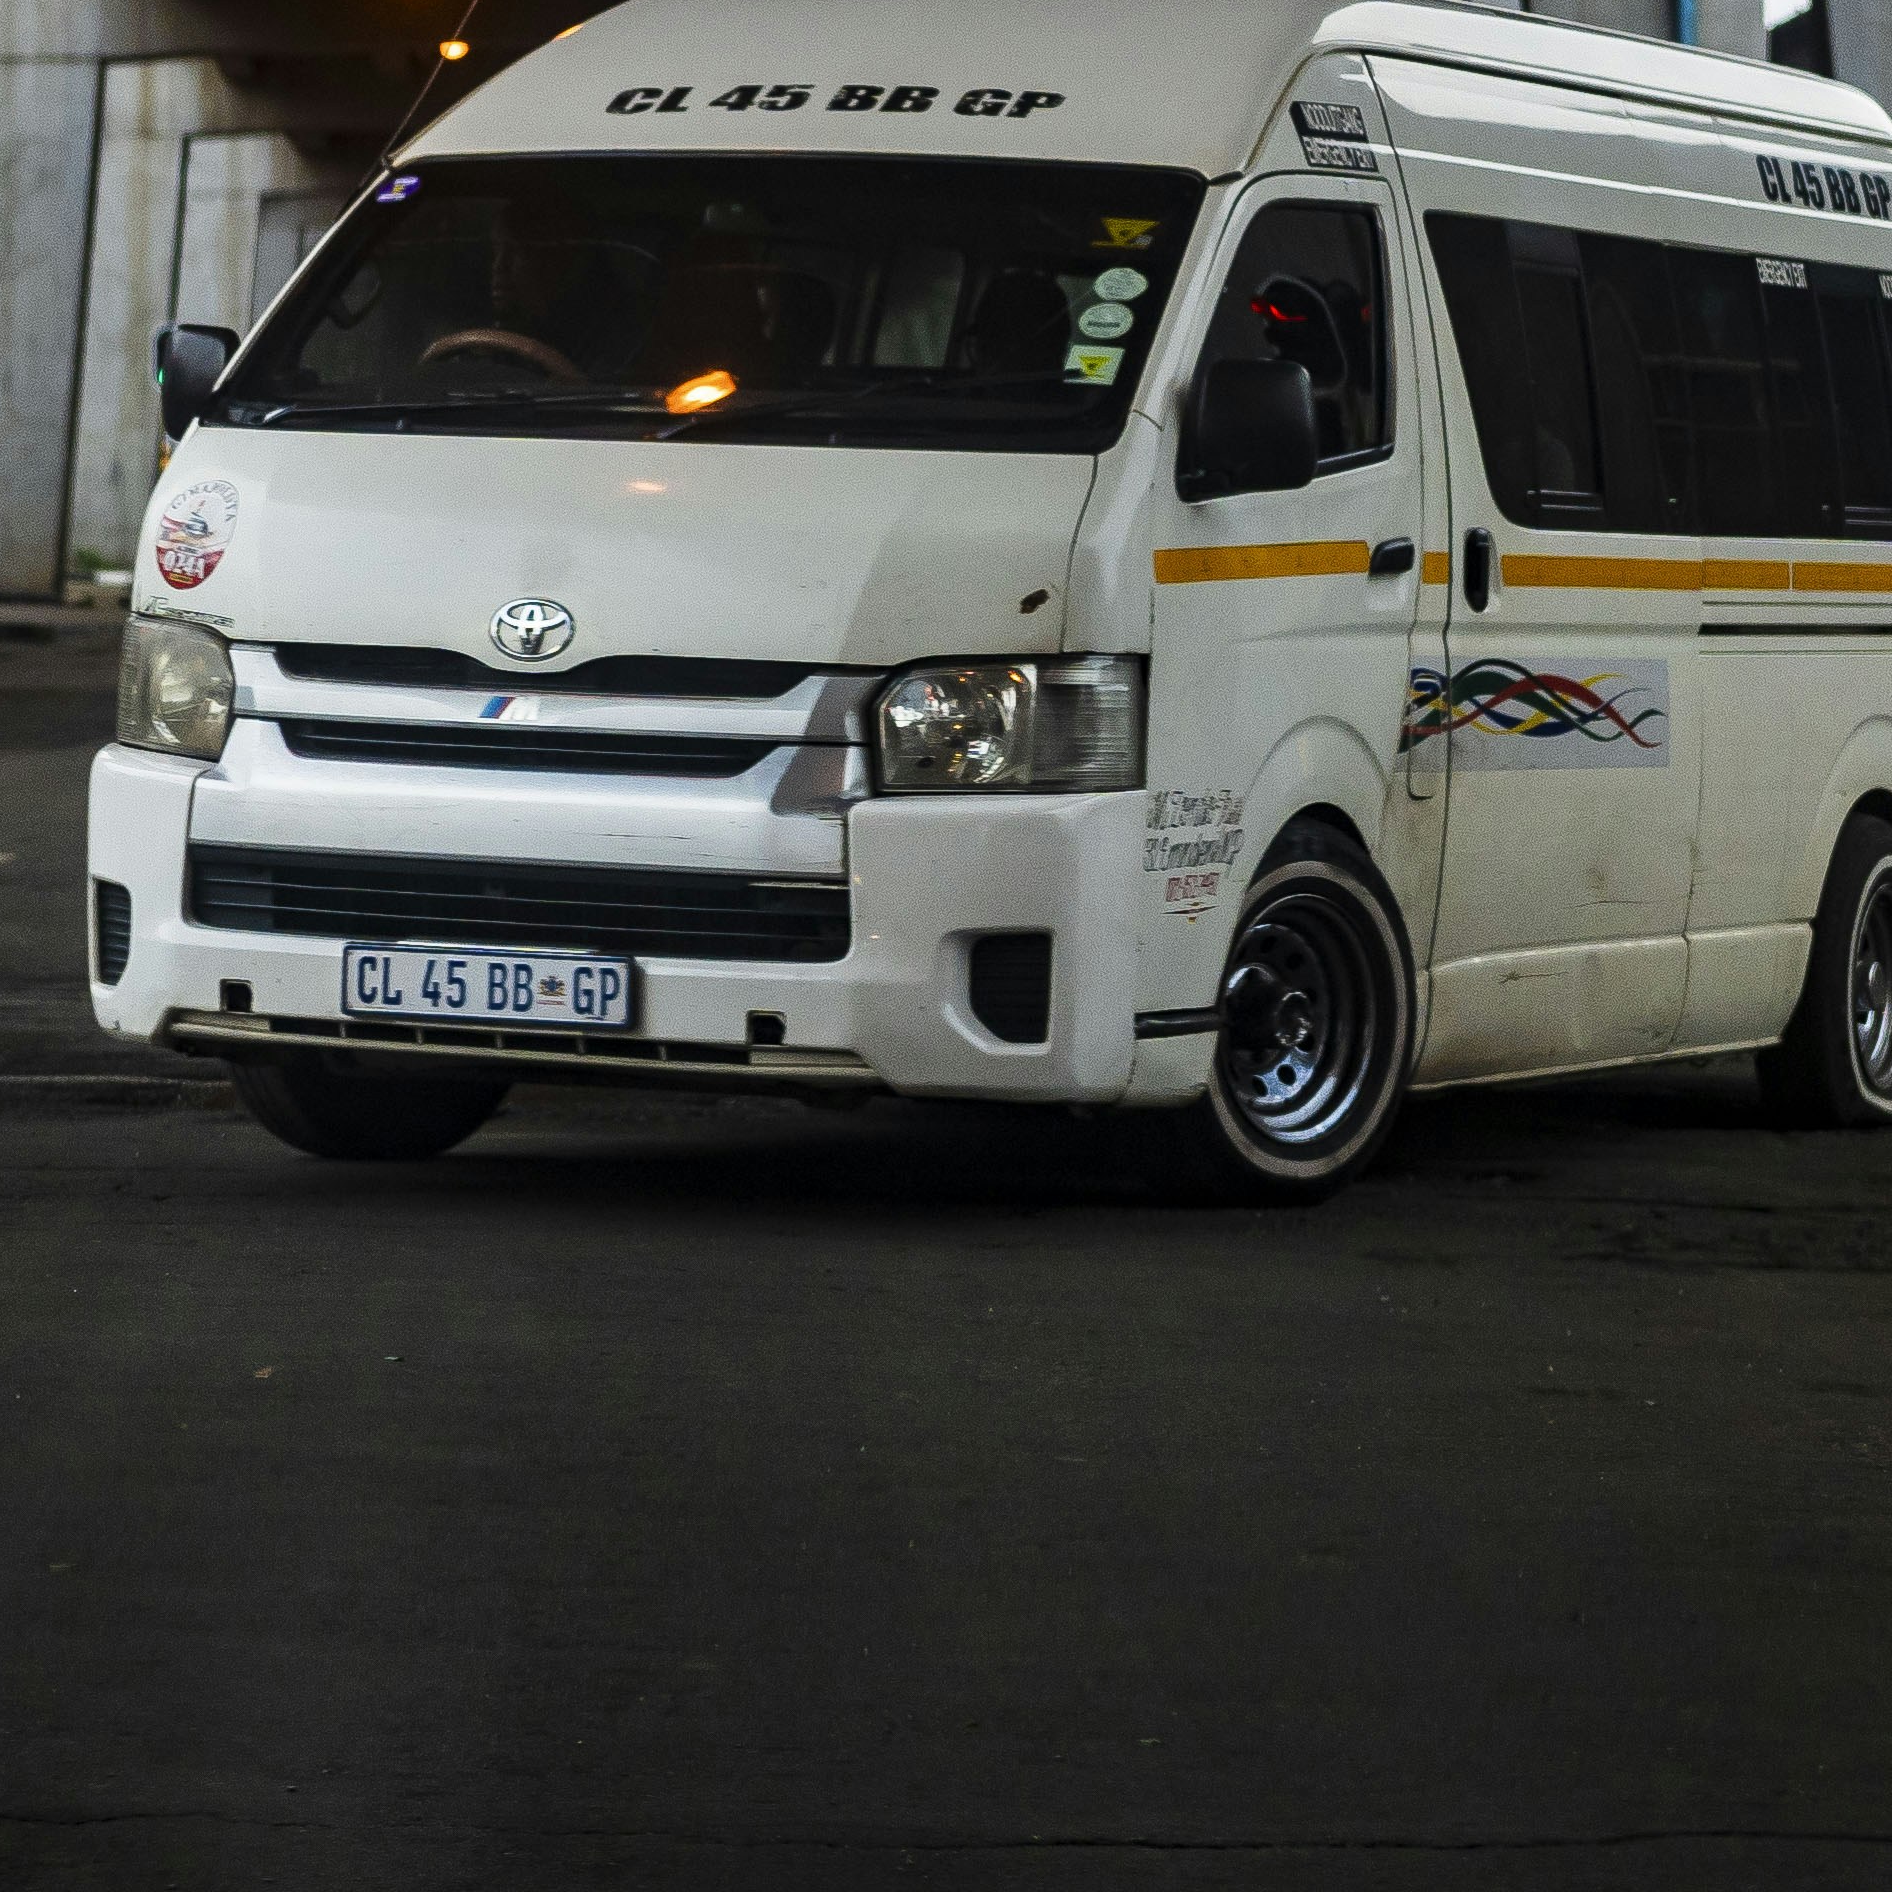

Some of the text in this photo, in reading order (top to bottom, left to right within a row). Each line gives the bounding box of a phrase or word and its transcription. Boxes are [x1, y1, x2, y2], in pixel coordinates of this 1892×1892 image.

[606, 84, 1067, 118] CL 45 BB GP
[1756, 154, 1891, 220] CL 45 BB GP
[357, 956, 621, 1016] CL 45 BB GP
